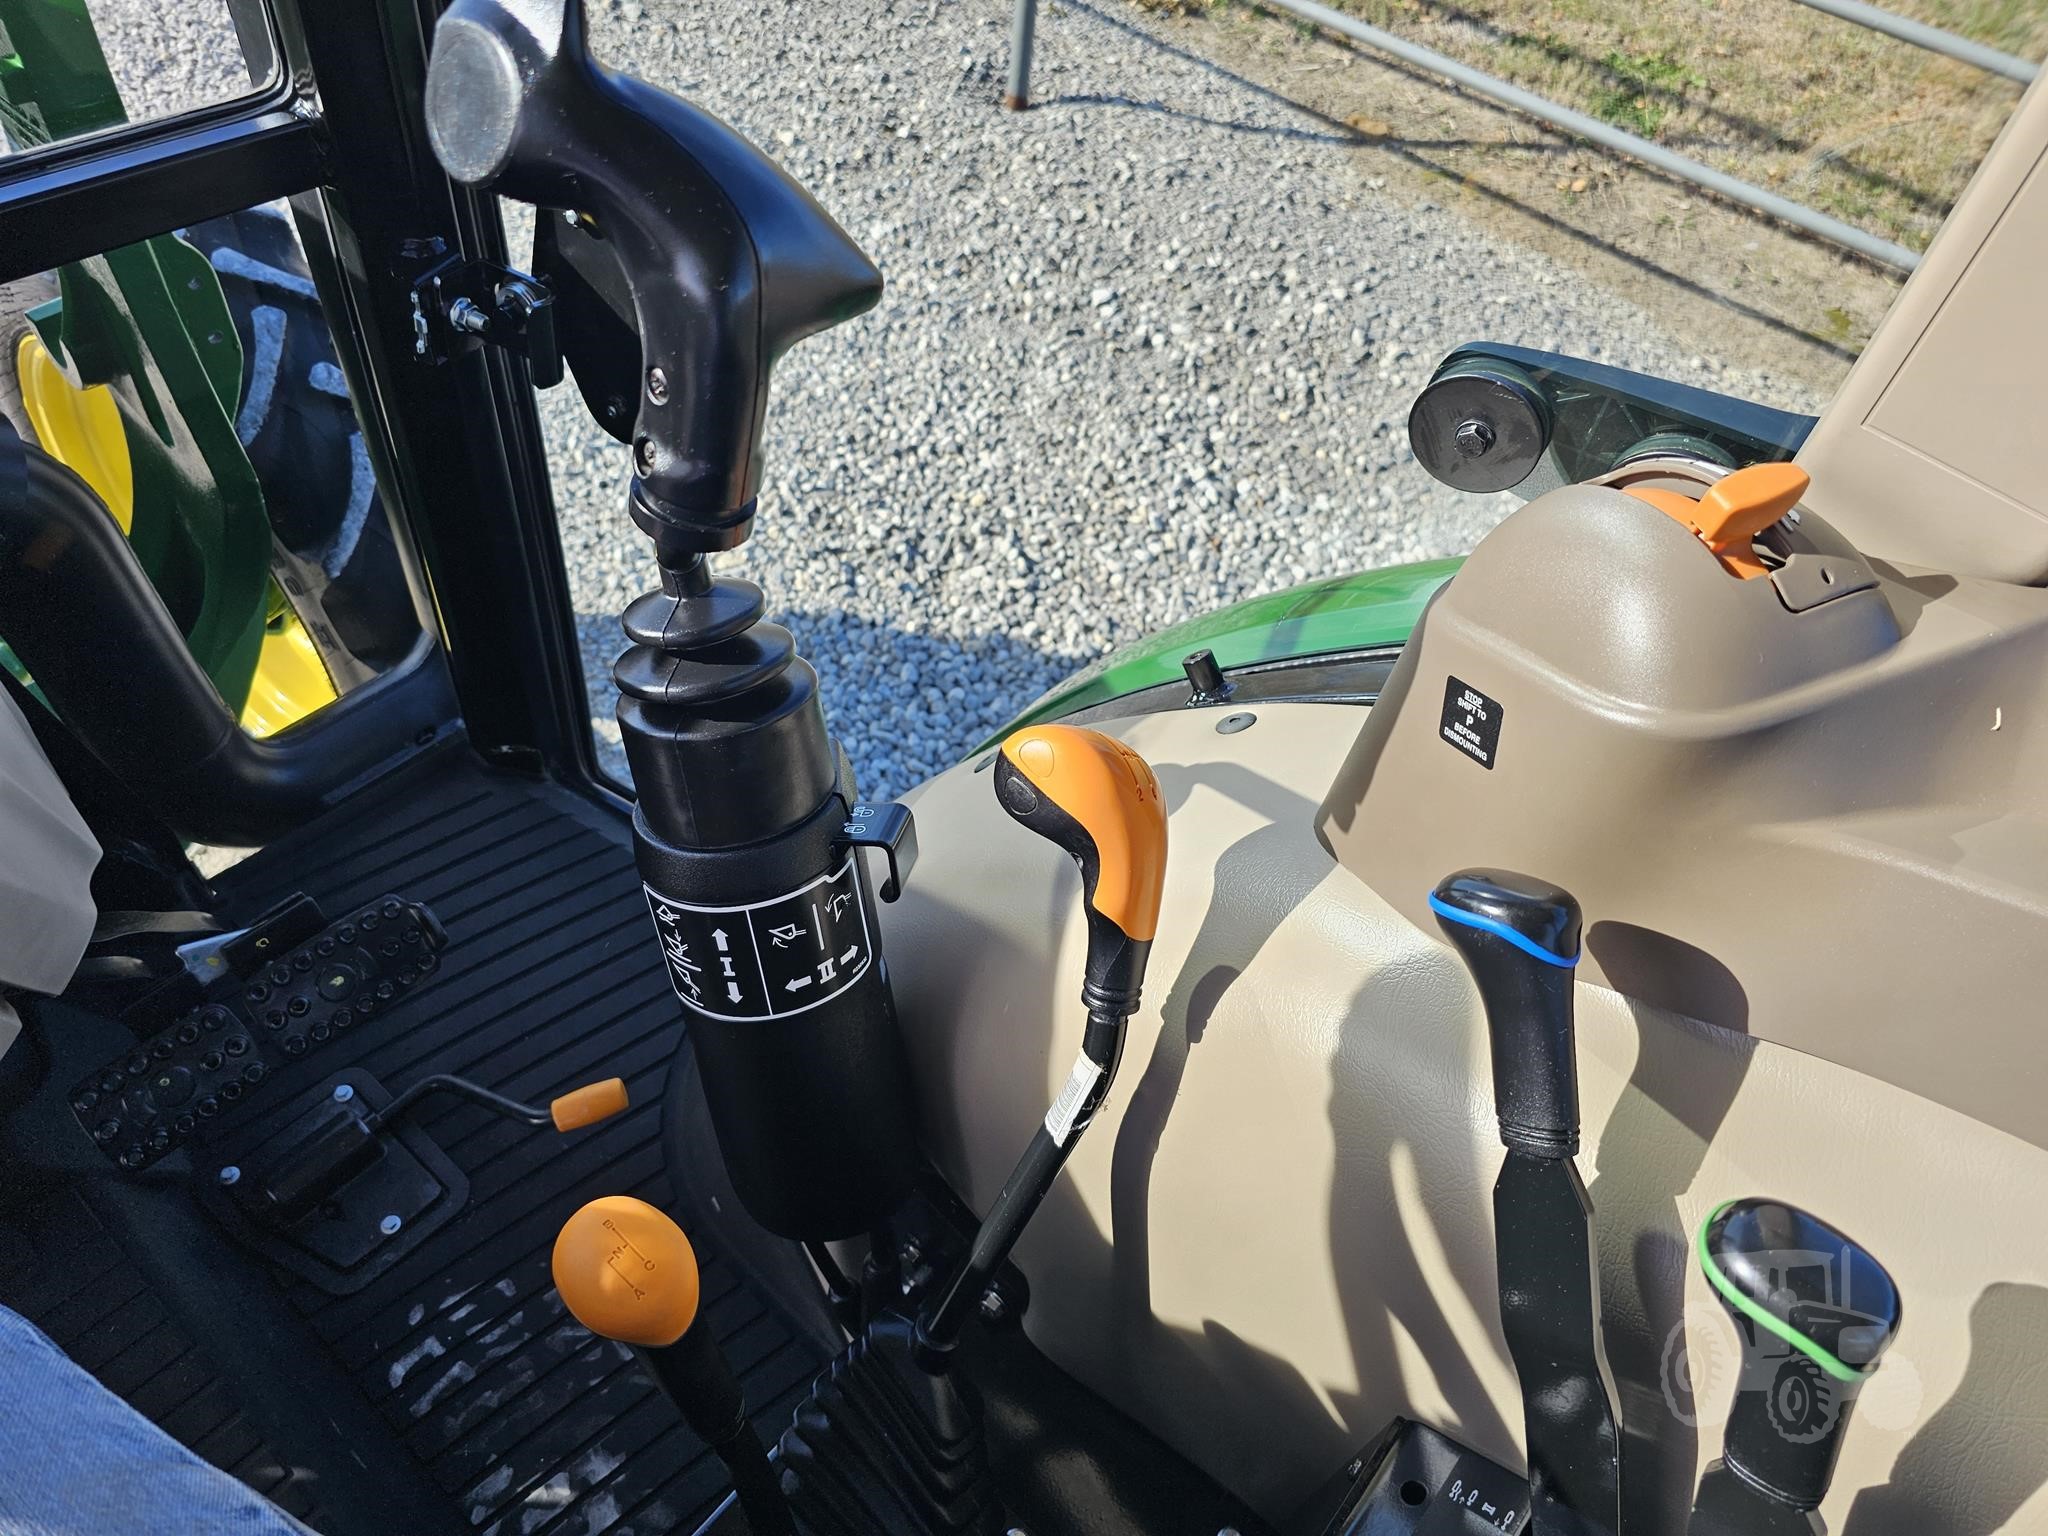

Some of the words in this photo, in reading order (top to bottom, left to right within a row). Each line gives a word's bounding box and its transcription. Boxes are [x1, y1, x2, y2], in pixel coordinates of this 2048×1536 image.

[1464, 690, 1483, 706] STOP
[1457, 697, 1477, 714] SHIFT
[1477, 709, 1487, 721] TO
[1465, 714, 1474, 726] P
[1454, 722, 1481, 745] BEFORE
[1444, 726, 1487, 761] DISMOUNTING
[1136, 786, 1144, 802] 2
[602, 1219, 614, 1230] B
[612, 1246, 625, 1259] N
[644, 1260, 656, 1272] C
[633, 1287, 646, 1301] A
